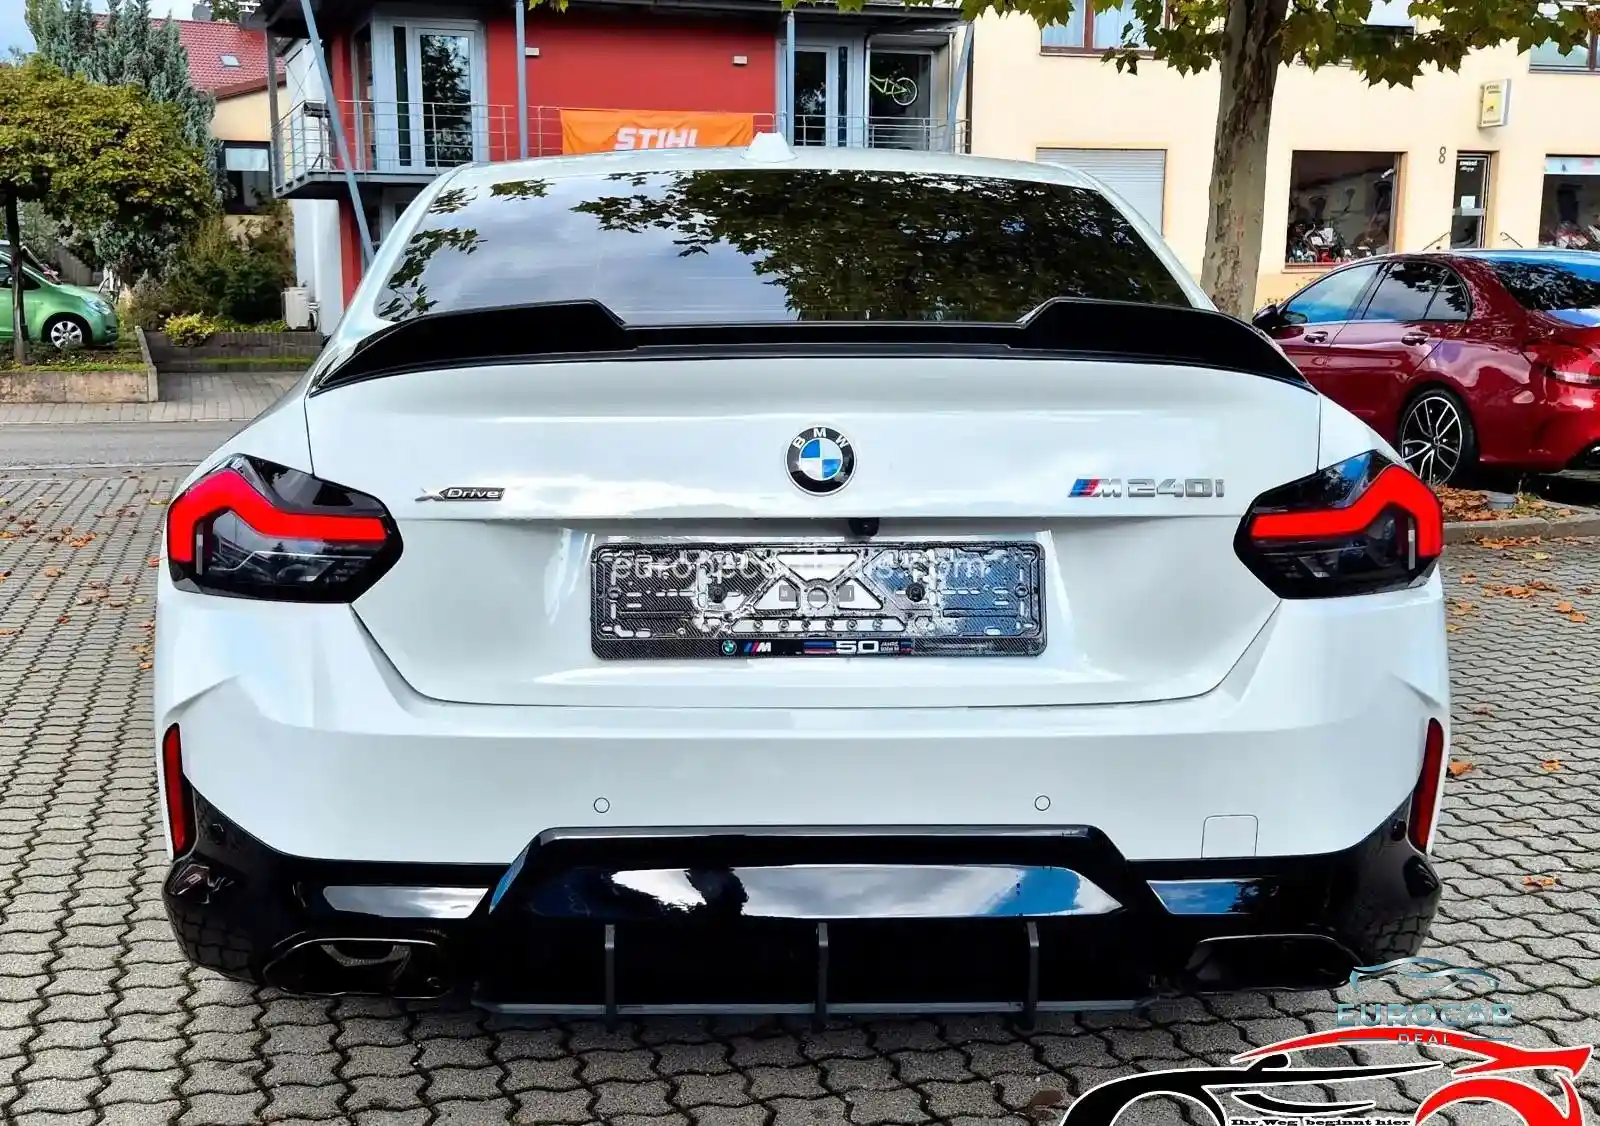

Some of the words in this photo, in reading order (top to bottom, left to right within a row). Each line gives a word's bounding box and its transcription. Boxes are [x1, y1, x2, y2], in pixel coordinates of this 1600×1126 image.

[1438, 146, 1447, 164] 8
[792, 427, 850, 449] BMW
[835, 640, 879, 654] 50
